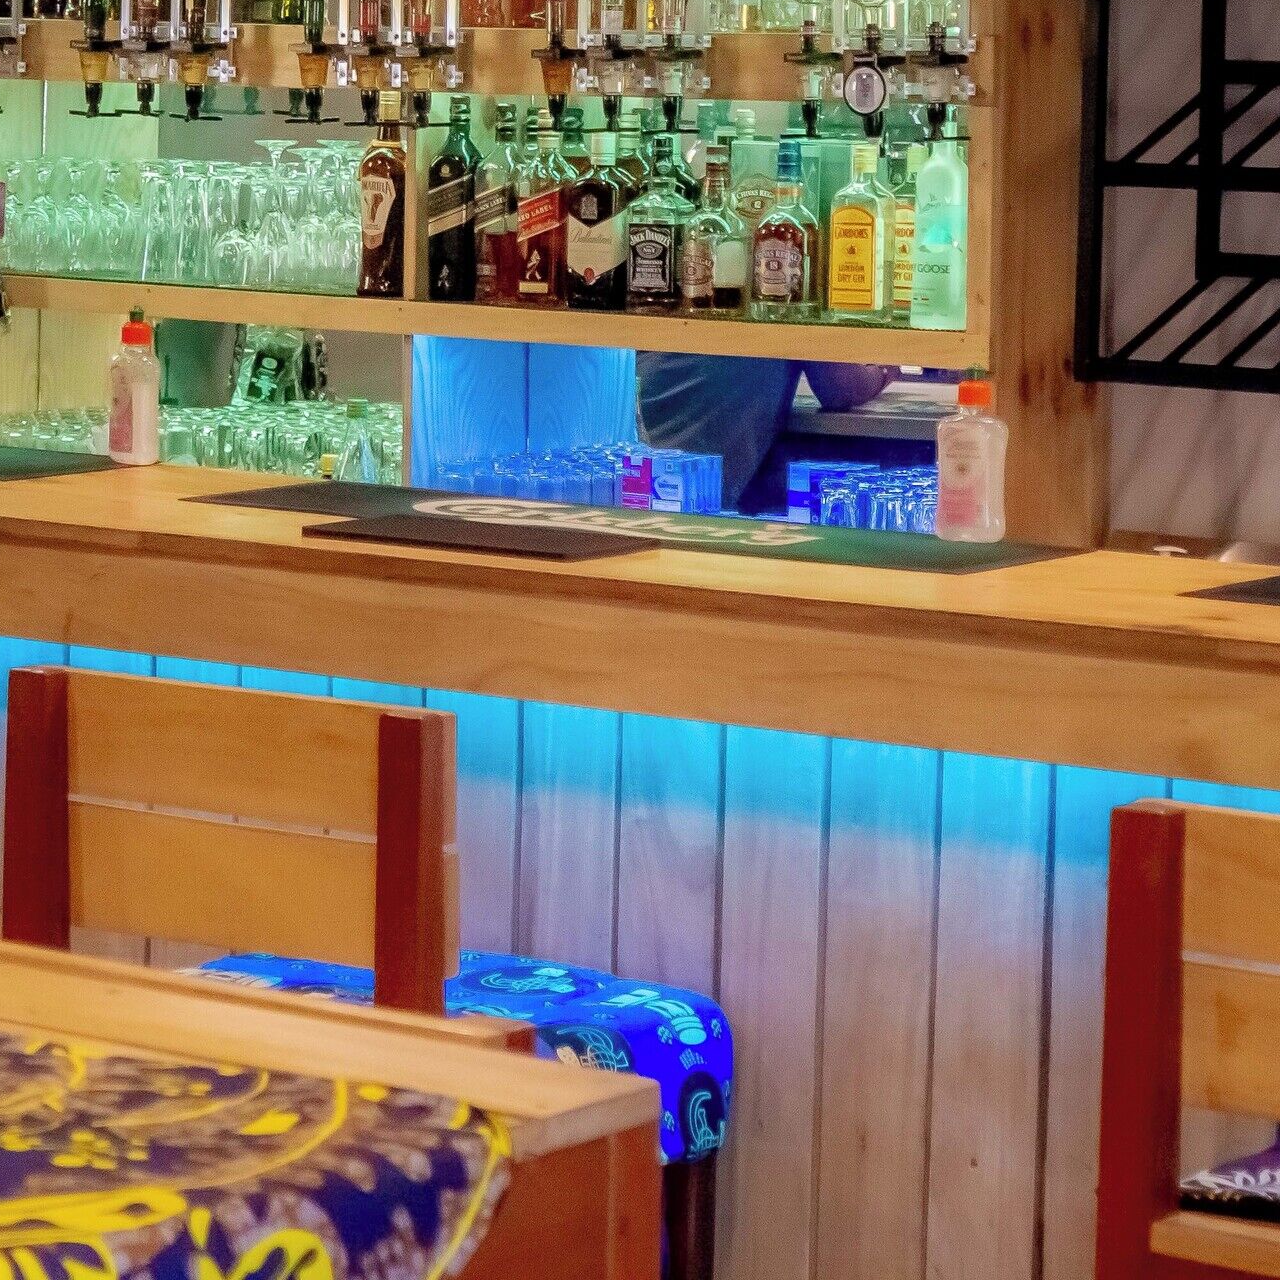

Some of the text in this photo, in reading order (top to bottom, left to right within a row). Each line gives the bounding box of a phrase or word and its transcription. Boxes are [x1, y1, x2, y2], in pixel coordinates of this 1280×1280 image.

[531, 204, 553, 218] LABEL
[917, 264, 951, 274] GOOSE
[412, 497, 822, 546] Carlsberg
